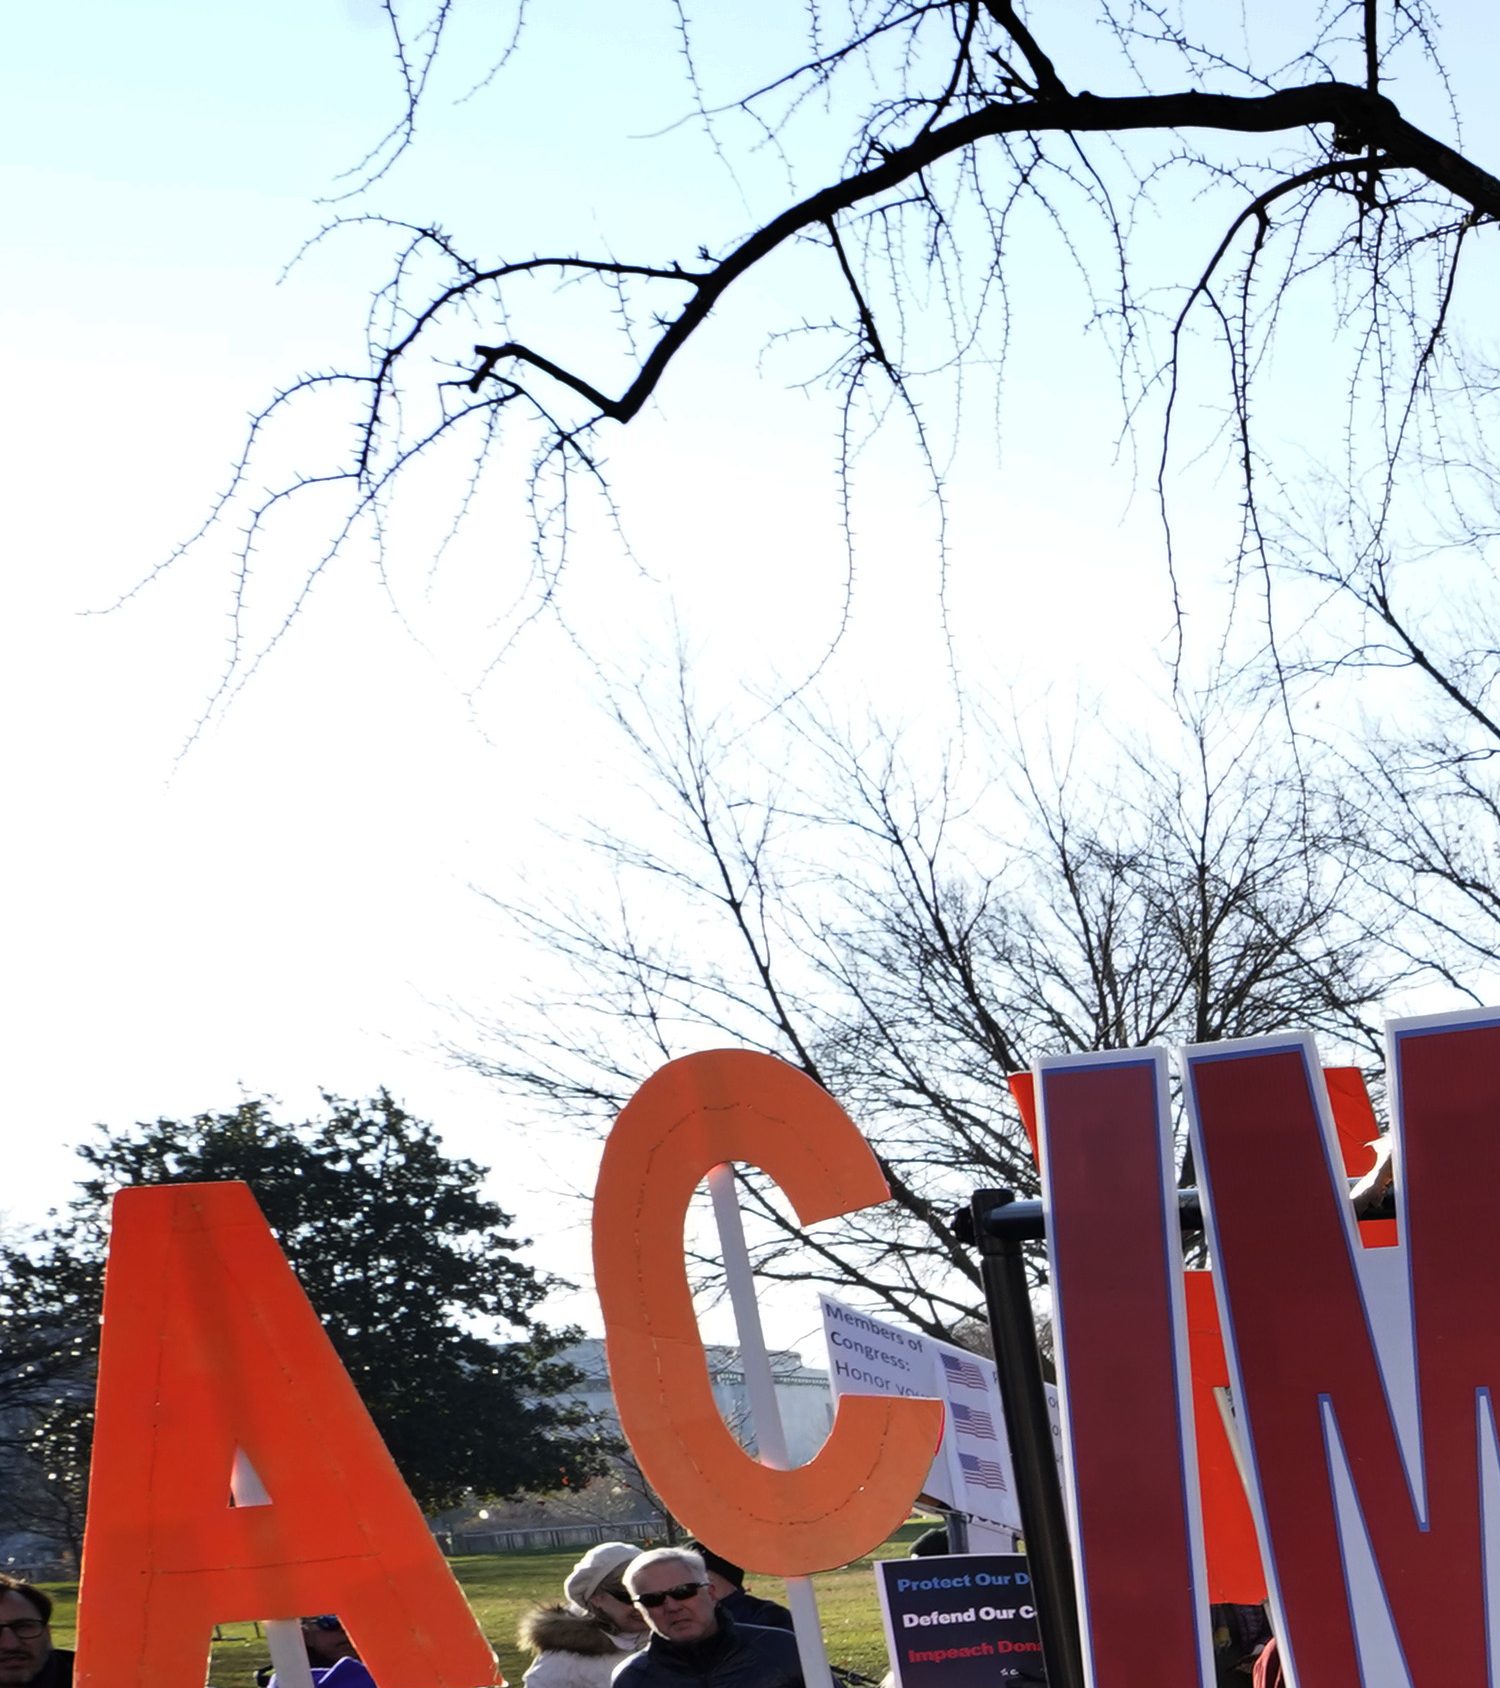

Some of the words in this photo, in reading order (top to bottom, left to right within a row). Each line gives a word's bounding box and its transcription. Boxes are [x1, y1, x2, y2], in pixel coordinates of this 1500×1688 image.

[825, 1303, 904, 1346] Members
[908, 1338, 924, 1353] of
[830, 1331, 911, 1372] Congress:
[835, 1359, 891, 1391] Honor
[896, 1574, 971, 1592] Protect
[975, 1573, 1011, 1587] Our
[902, 1608, 976, 1628] Defend
[979, 1606, 1016, 1621] Our
[1019, 1605, 1038, 1619] C
[908, 1642, 994, 1663] Impeach
